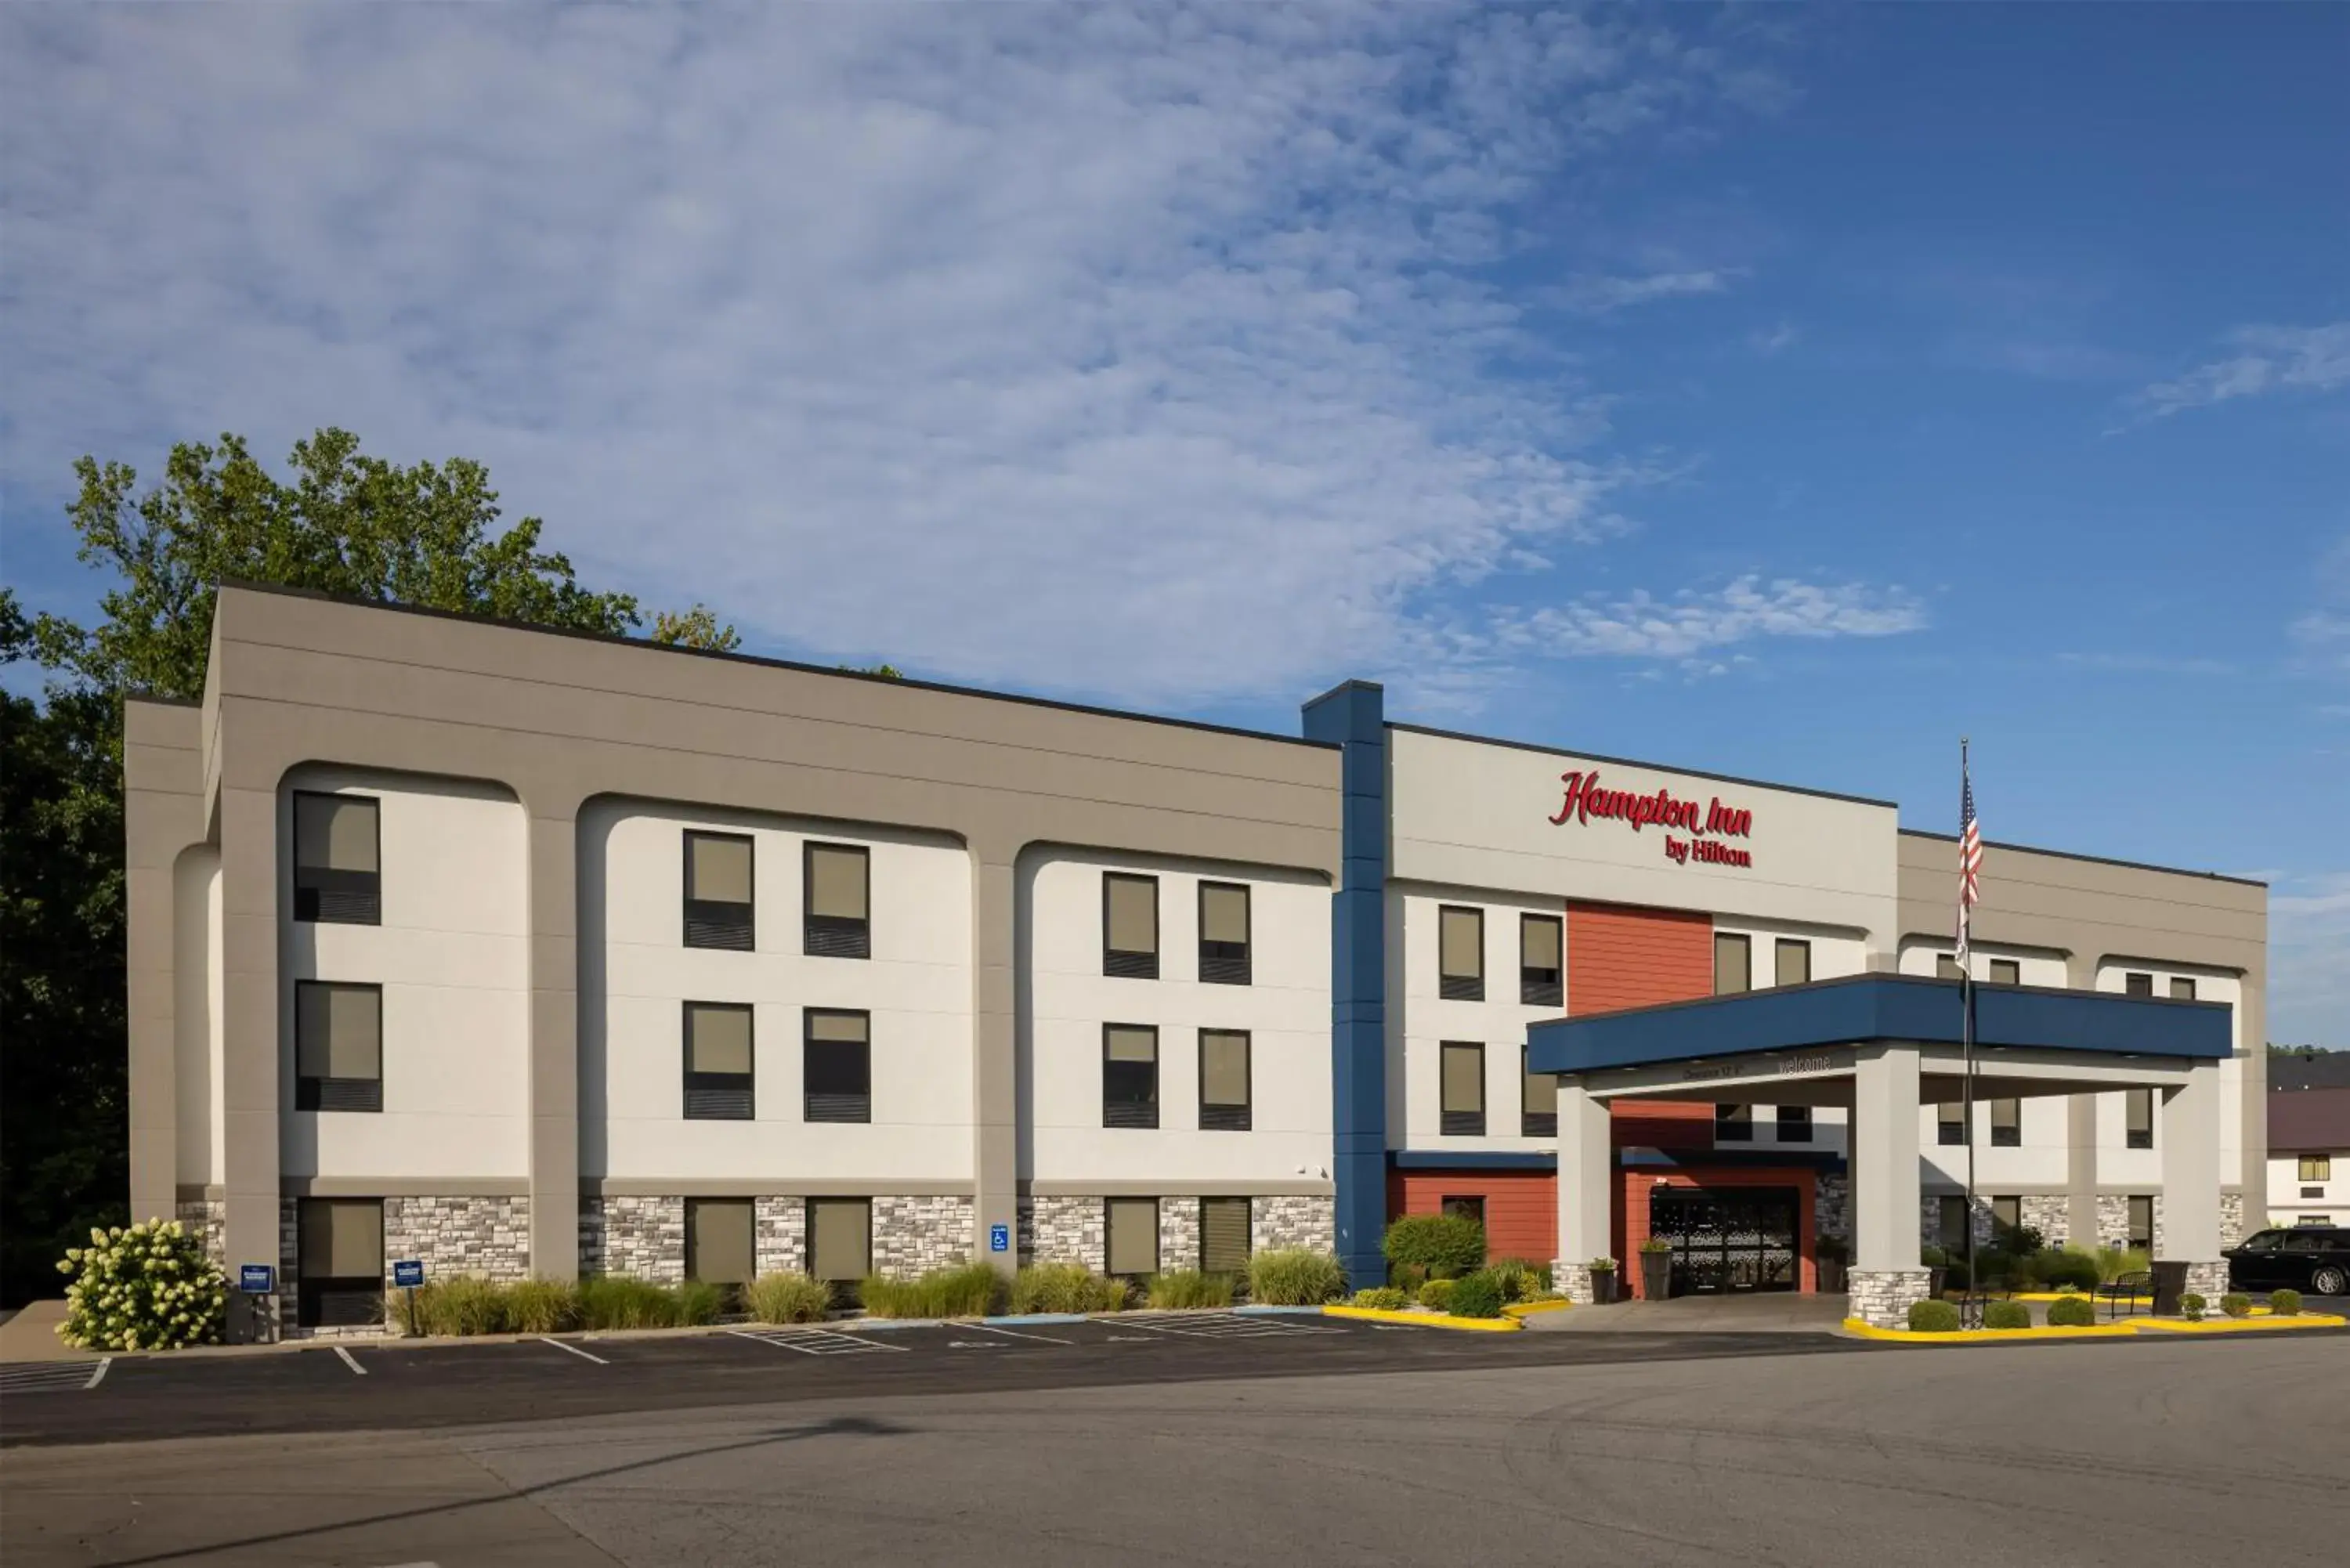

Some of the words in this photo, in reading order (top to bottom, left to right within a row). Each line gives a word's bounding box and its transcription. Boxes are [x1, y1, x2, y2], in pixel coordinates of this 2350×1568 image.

[1548, 771, 1705, 836] Hampton
[1705, 797, 1752, 838] Inn
[1665, 834, 1690, 865] by
[1691, 838, 1752, 869] Hilton
[1780, 1056, 1831, 1075] welcome
